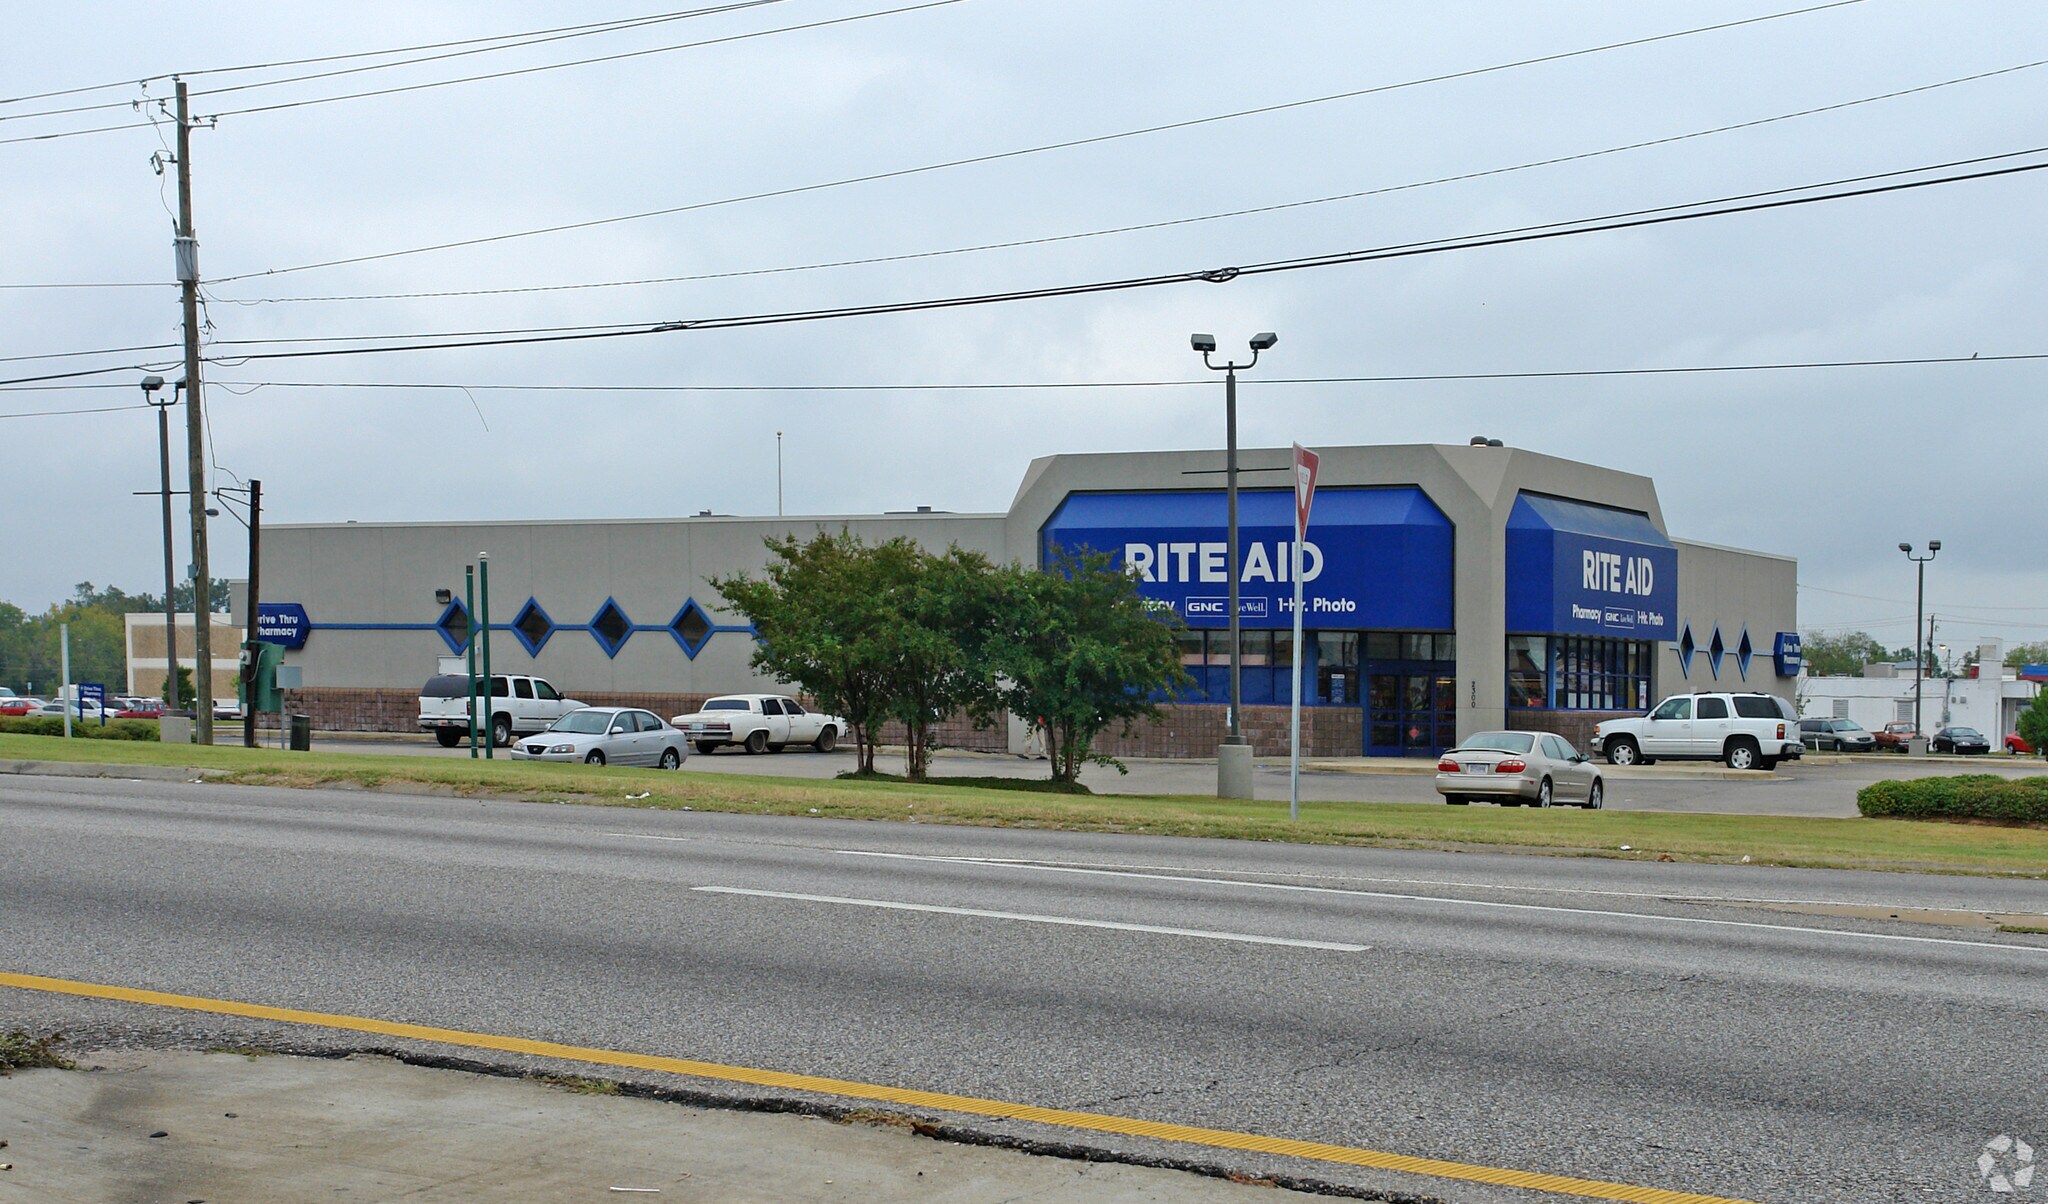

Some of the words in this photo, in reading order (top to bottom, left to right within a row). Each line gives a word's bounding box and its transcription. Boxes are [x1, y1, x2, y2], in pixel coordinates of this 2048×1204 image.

[1124, 542, 1228, 583] RITE
[1240, 541, 1324, 583] AID
[1583, 550, 1621, 592] RITE
[1624, 556, 1654, 596] AID
[1187, 602, 1223, 612] GNC
[1313, 597, 1356, 613] Photo
[1572, 604, 1601, 624] Pharmacy
[1605, 612, 1619, 622] GNC
[258, 614, 276, 624] rive
[278, 614, 298, 624] Thru
[258, 627, 298, 638] harmacy
